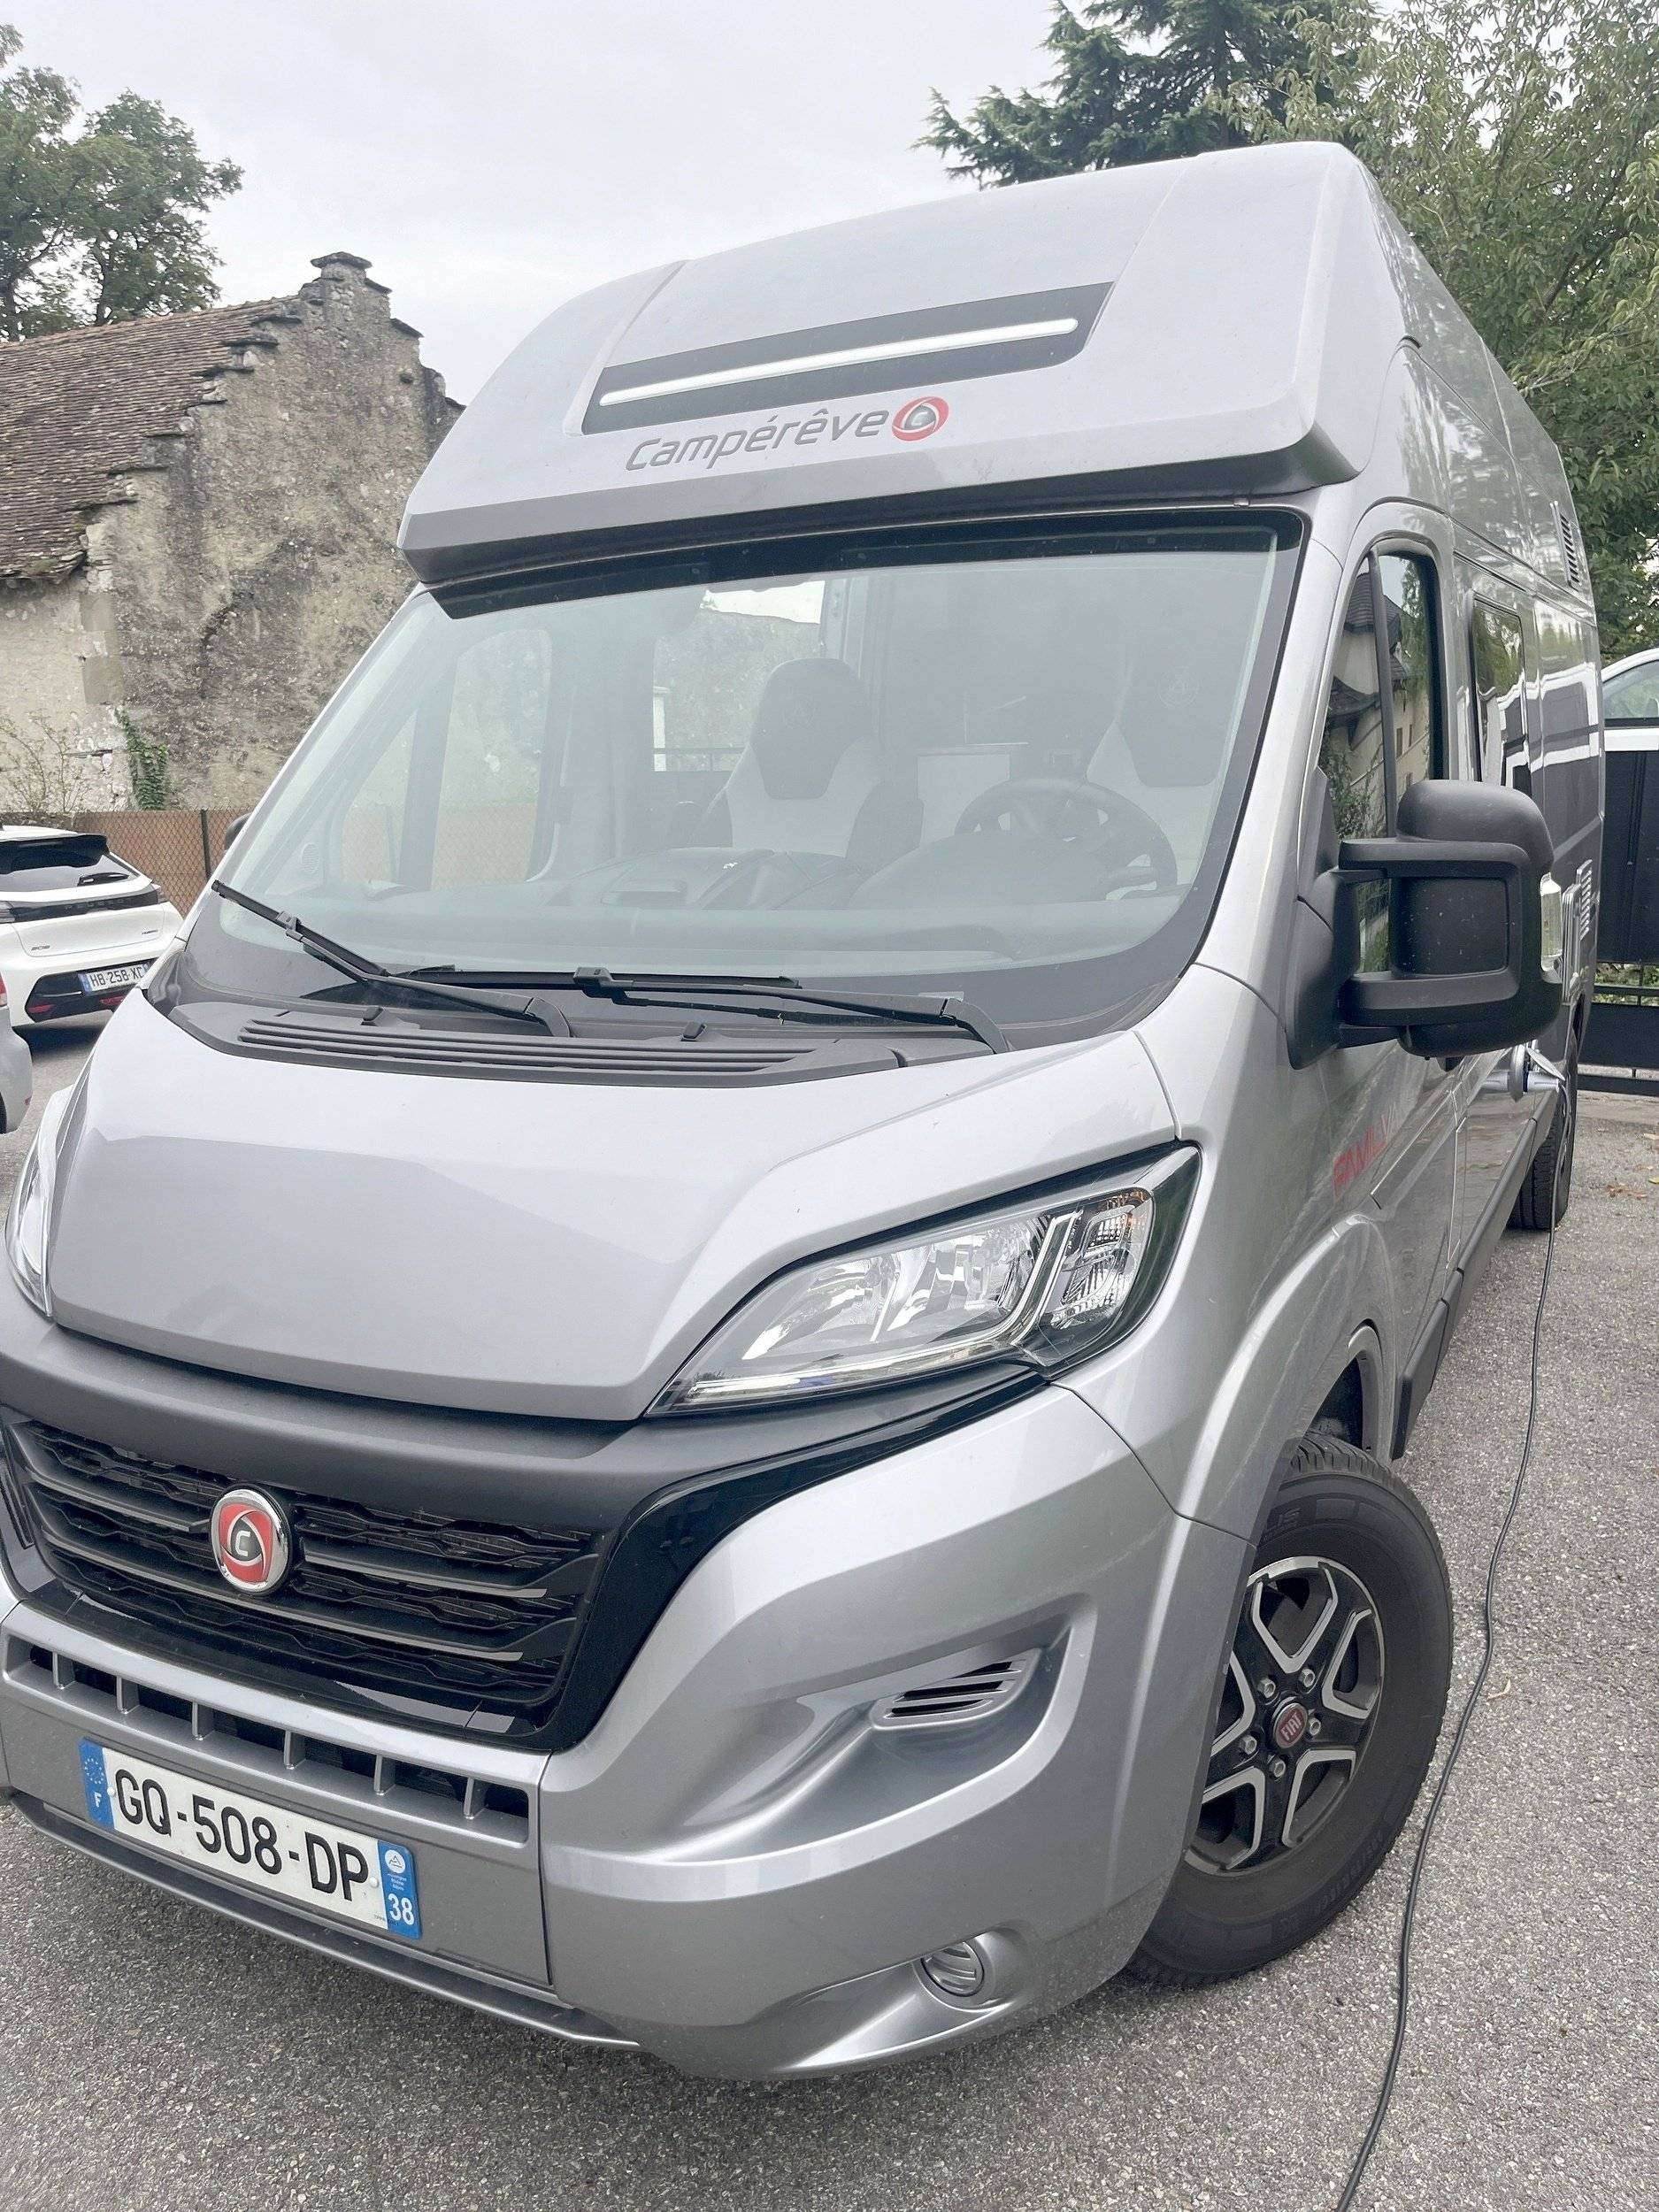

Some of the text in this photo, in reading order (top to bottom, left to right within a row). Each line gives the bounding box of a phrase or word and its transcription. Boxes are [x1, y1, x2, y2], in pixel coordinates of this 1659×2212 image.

[625, 408, 889, 471] Campérêve
[1280, 1712, 1302, 1741] FIAT
[94, 1792, 102, 1808] F
[115, 1770, 369, 1901] GQ-508-DP
[388, 1893, 415, 1925] 38
